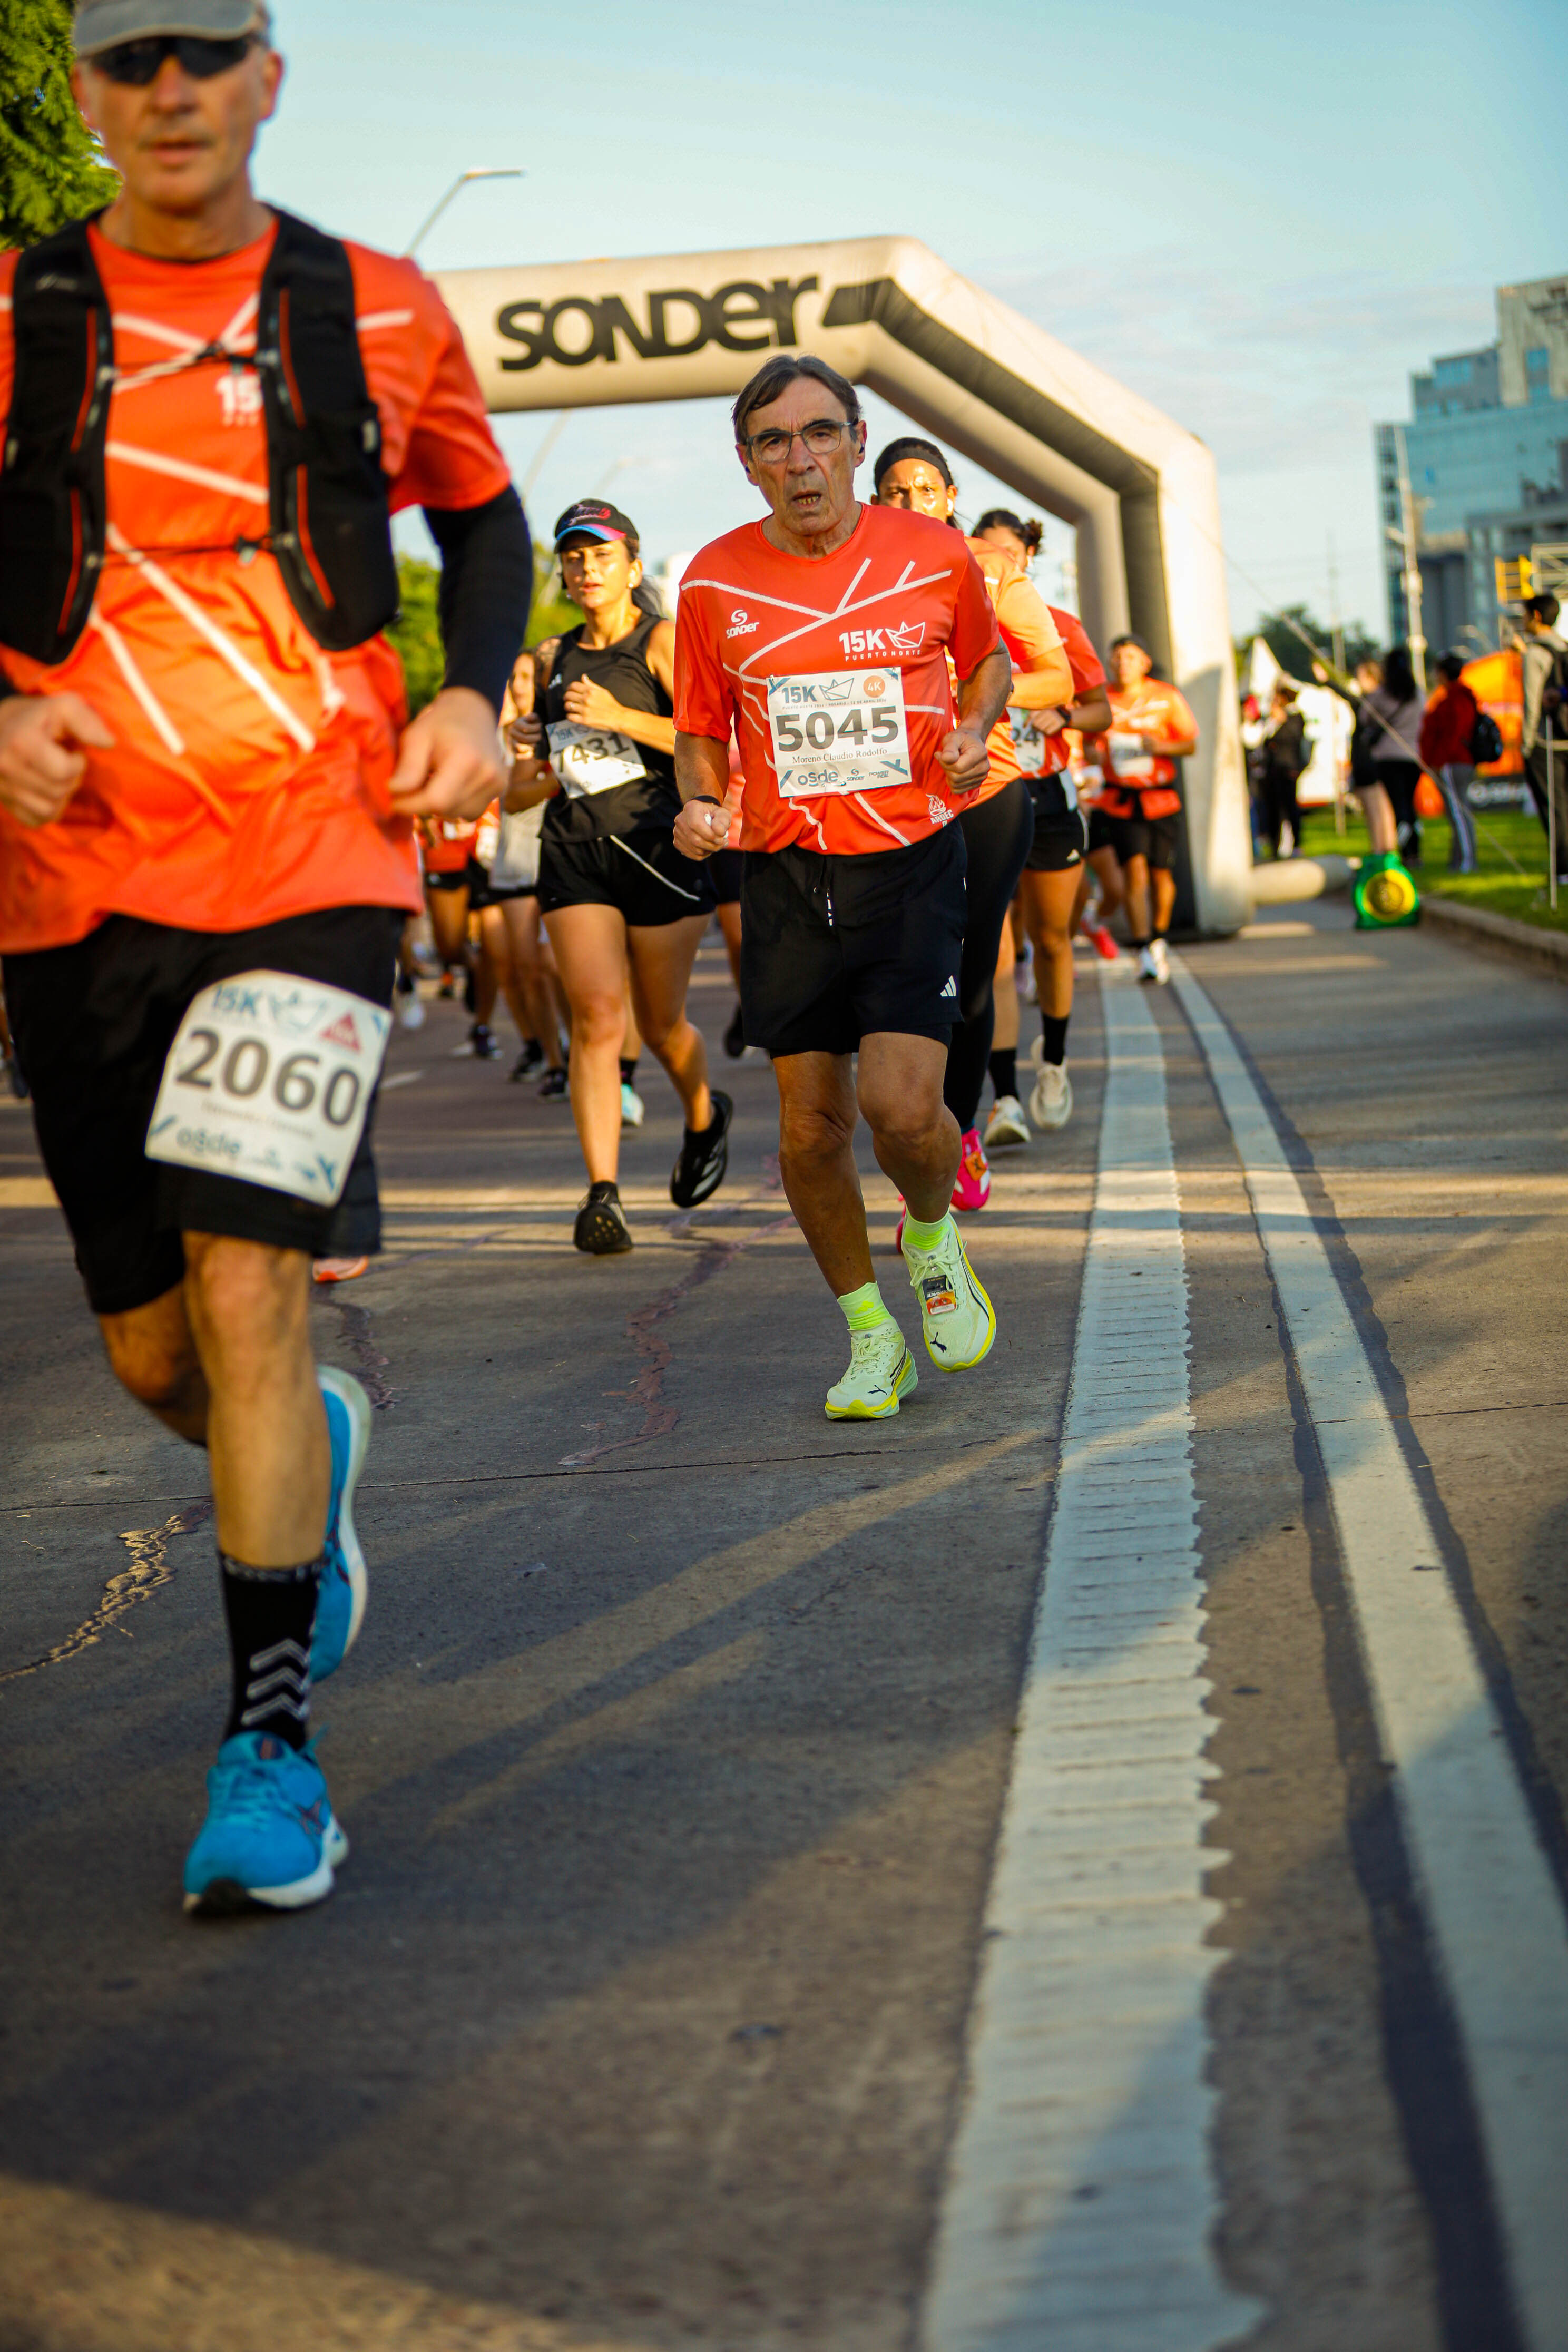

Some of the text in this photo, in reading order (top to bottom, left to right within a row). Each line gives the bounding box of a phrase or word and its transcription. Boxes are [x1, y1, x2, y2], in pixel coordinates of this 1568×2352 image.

[215, 375, 262, 410] 15
[839, 629, 886, 654] 15K
[845, 652, 887, 662] PUERTO
[782, 685, 817, 703] 15K
[867, 682, 881, 691] 4K
[776, 706, 899, 752] 5045
[824, 753, 853, 761] Claudio
[856, 749, 887, 757] Rodolfo
[798, 769, 838, 786] osde
[930, 809, 954, 824] ARDEC
[212, 984, 262, 1017] 15K
[175, 1027, 360, 1127] 2060
